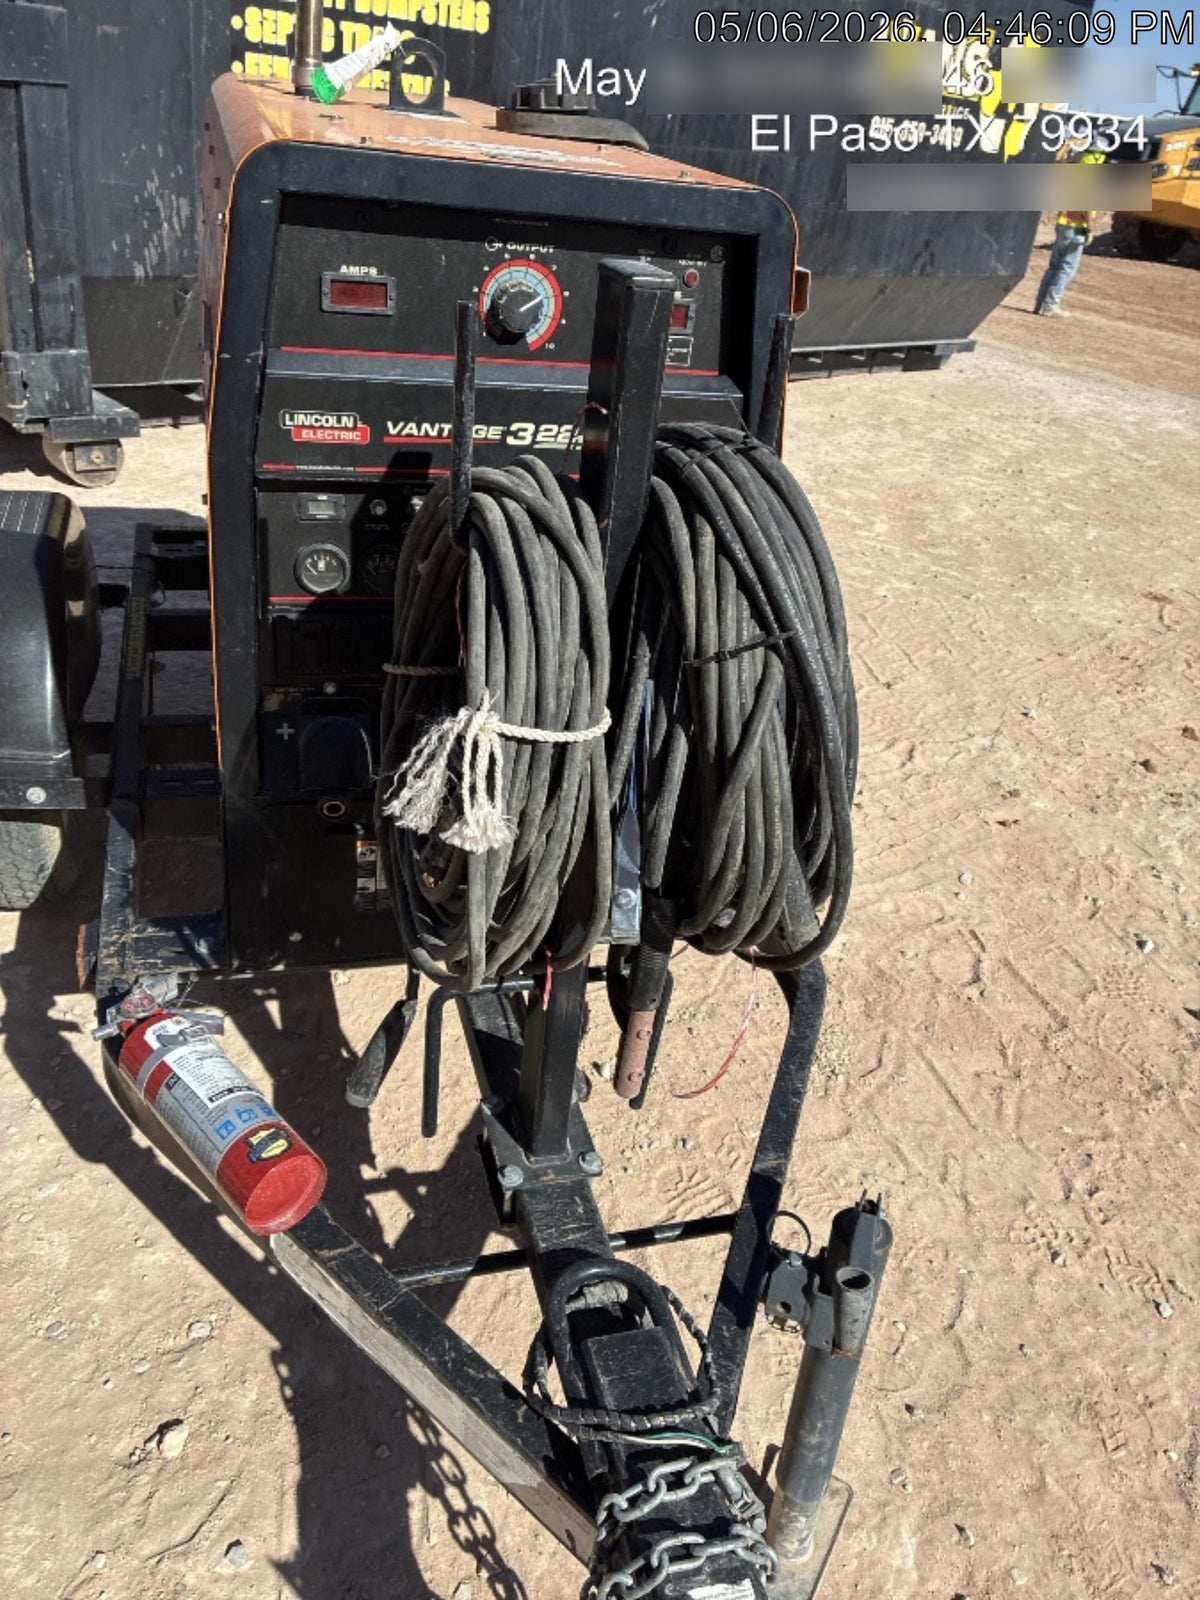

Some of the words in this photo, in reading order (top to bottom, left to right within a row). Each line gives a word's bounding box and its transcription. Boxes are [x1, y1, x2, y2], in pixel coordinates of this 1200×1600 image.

[245, 6, 334, 52] SEPC
[506, 242, 555, 253] OUTPUT
[340, 264, 377, 276] AMPS
[285, 413, 354, 428] LINCOLN
[301, 429, 361, 441] ELECTRIC
[387, 421, 503, 439] VANTGE
